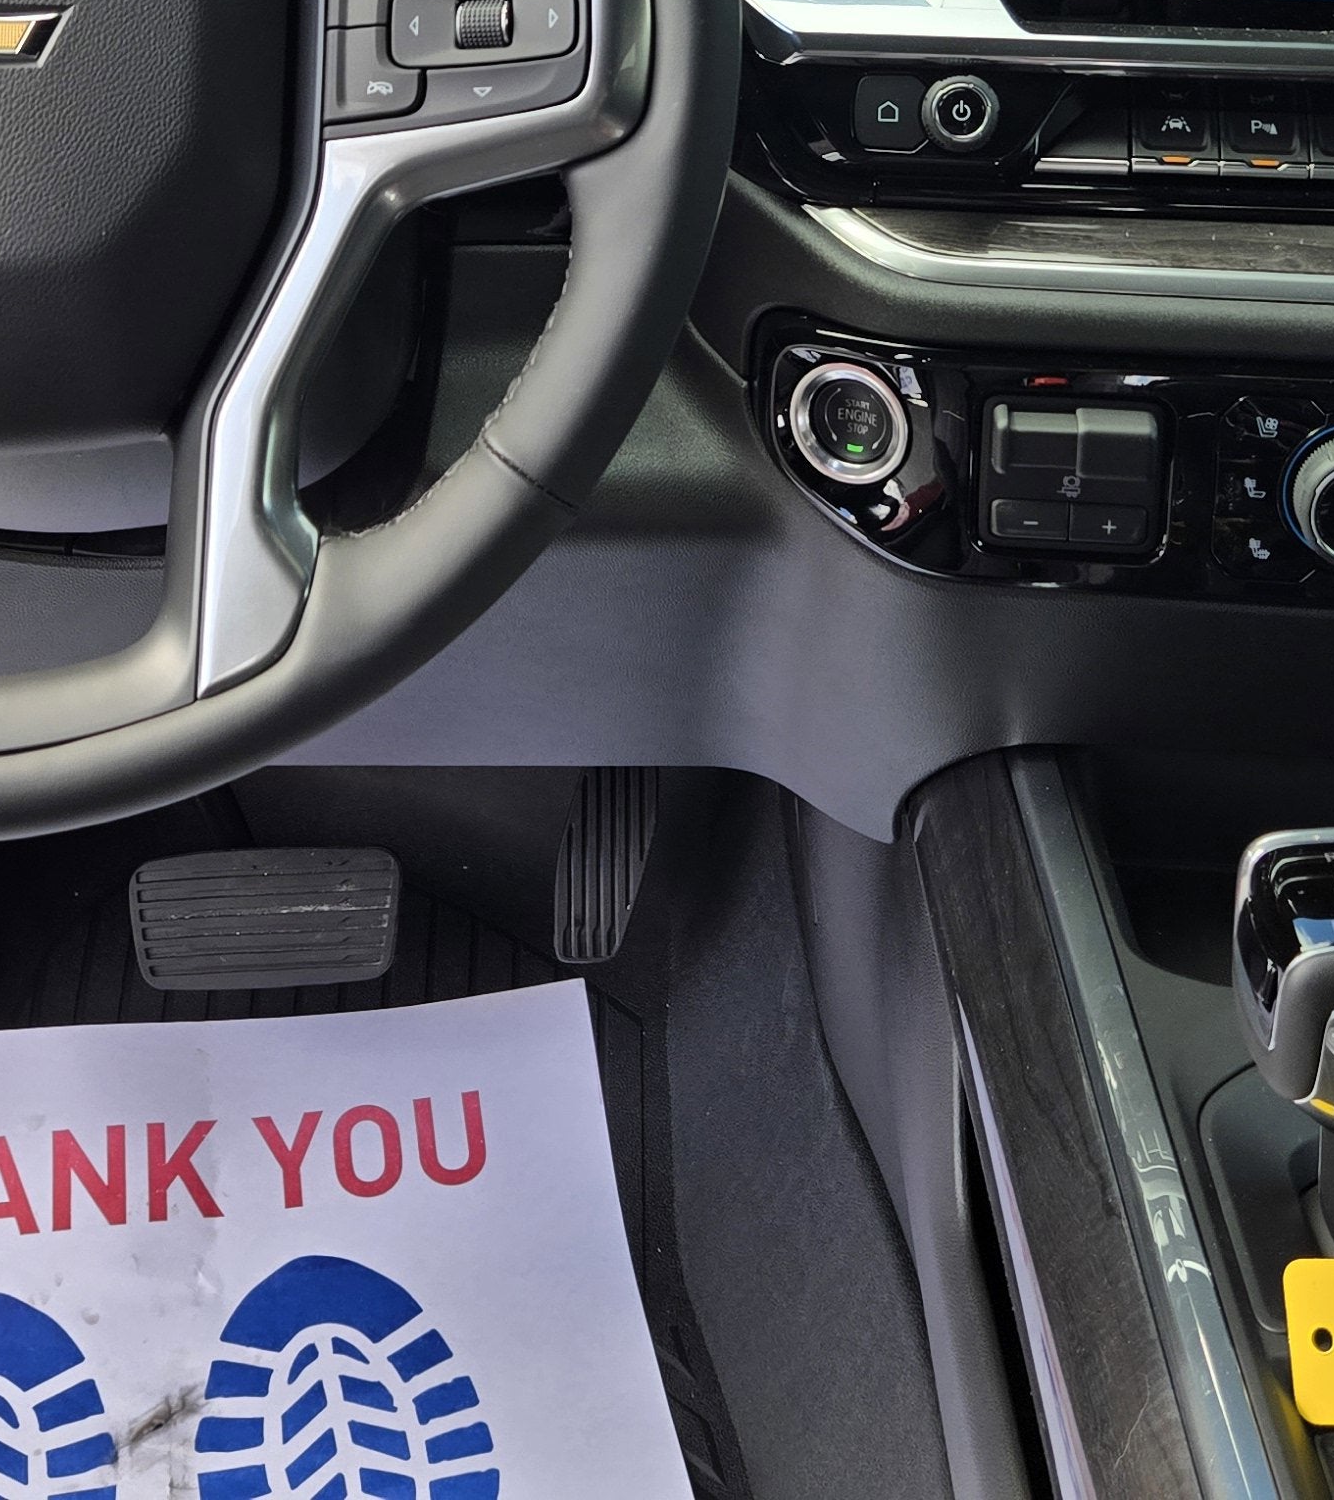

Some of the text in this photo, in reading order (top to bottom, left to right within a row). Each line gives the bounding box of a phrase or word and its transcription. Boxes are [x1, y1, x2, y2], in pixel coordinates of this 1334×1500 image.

[845, 399, 870, 410] START
[837, 407, 878, 427] ENGINE
[847, 421, 869, 435] STOP
[252, 1091, 490, 1209] YOU
